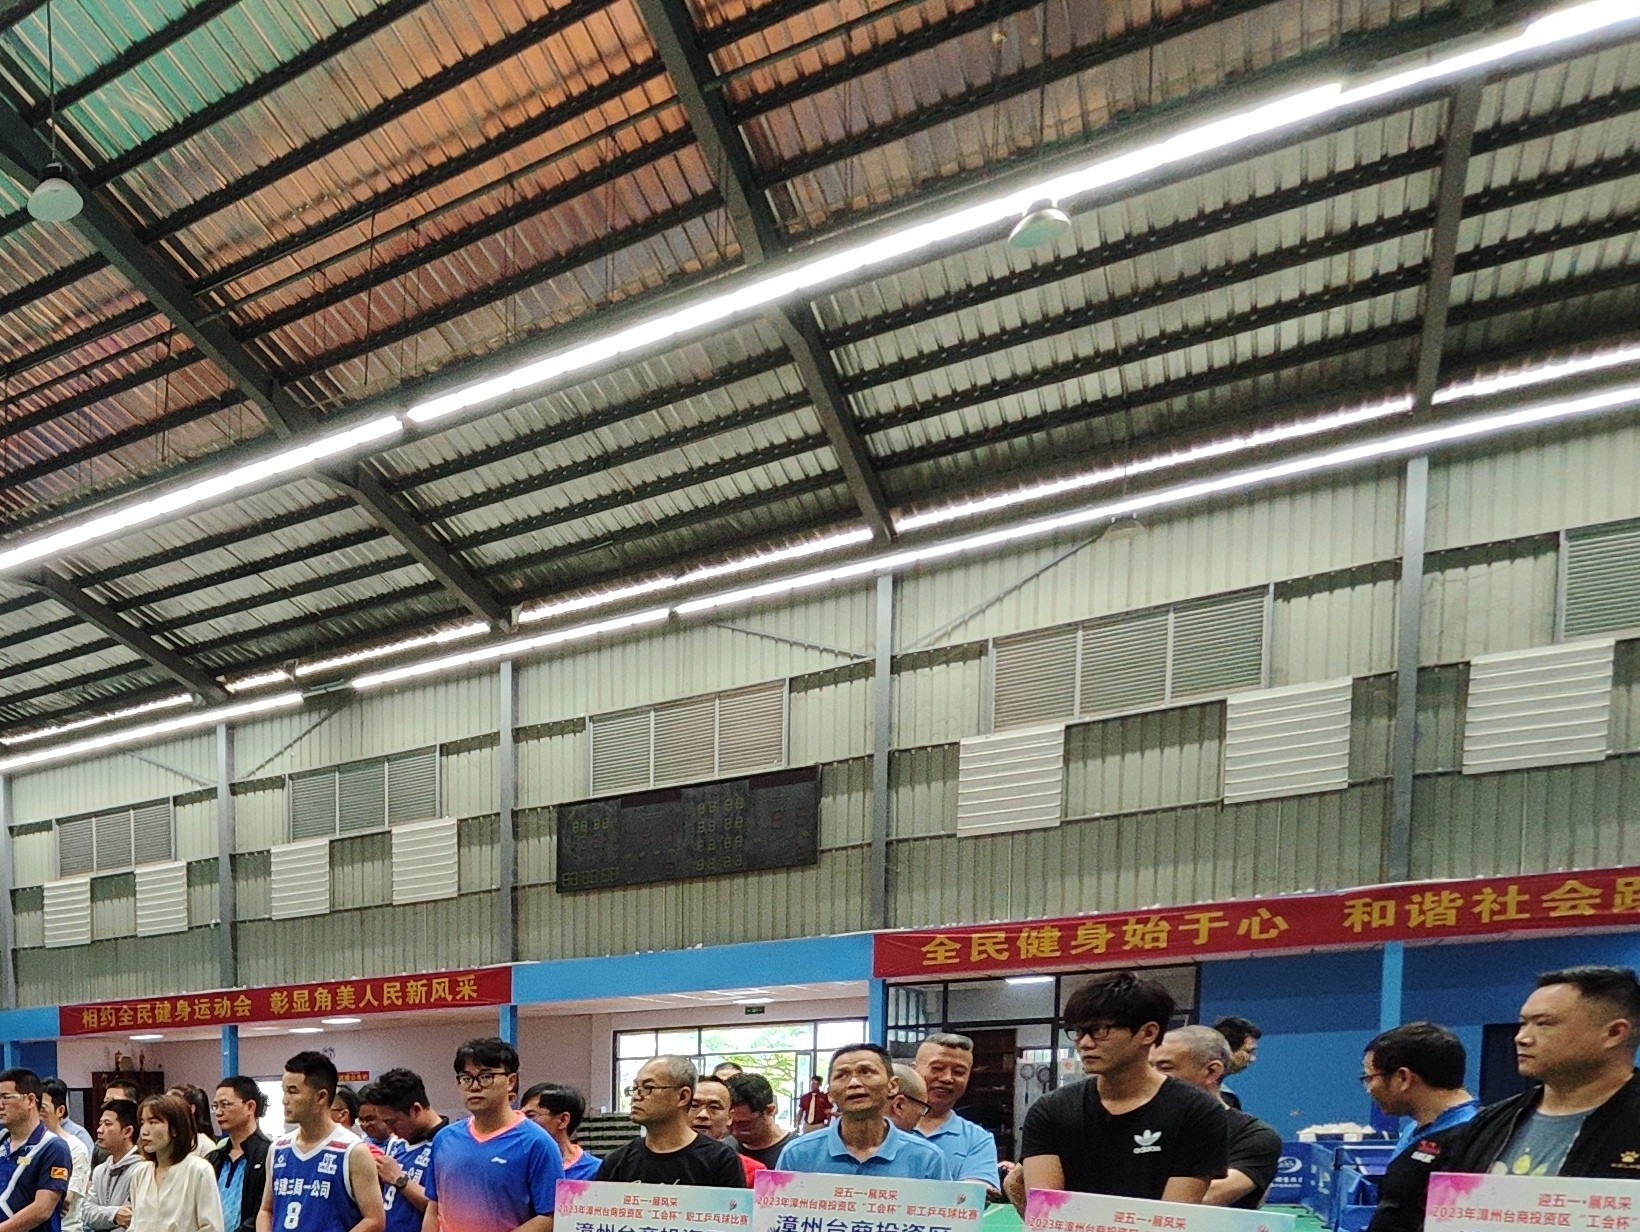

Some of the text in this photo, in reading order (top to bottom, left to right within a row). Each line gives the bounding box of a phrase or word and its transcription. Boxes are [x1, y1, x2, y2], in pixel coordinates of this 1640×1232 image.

[921, 907, 1290, 967] 全民健身始于心
[81, 973, 478, 1029] 相约全民健身运动会 彰显角美人民新风采
[284, 1201, 302, 1230] 8
